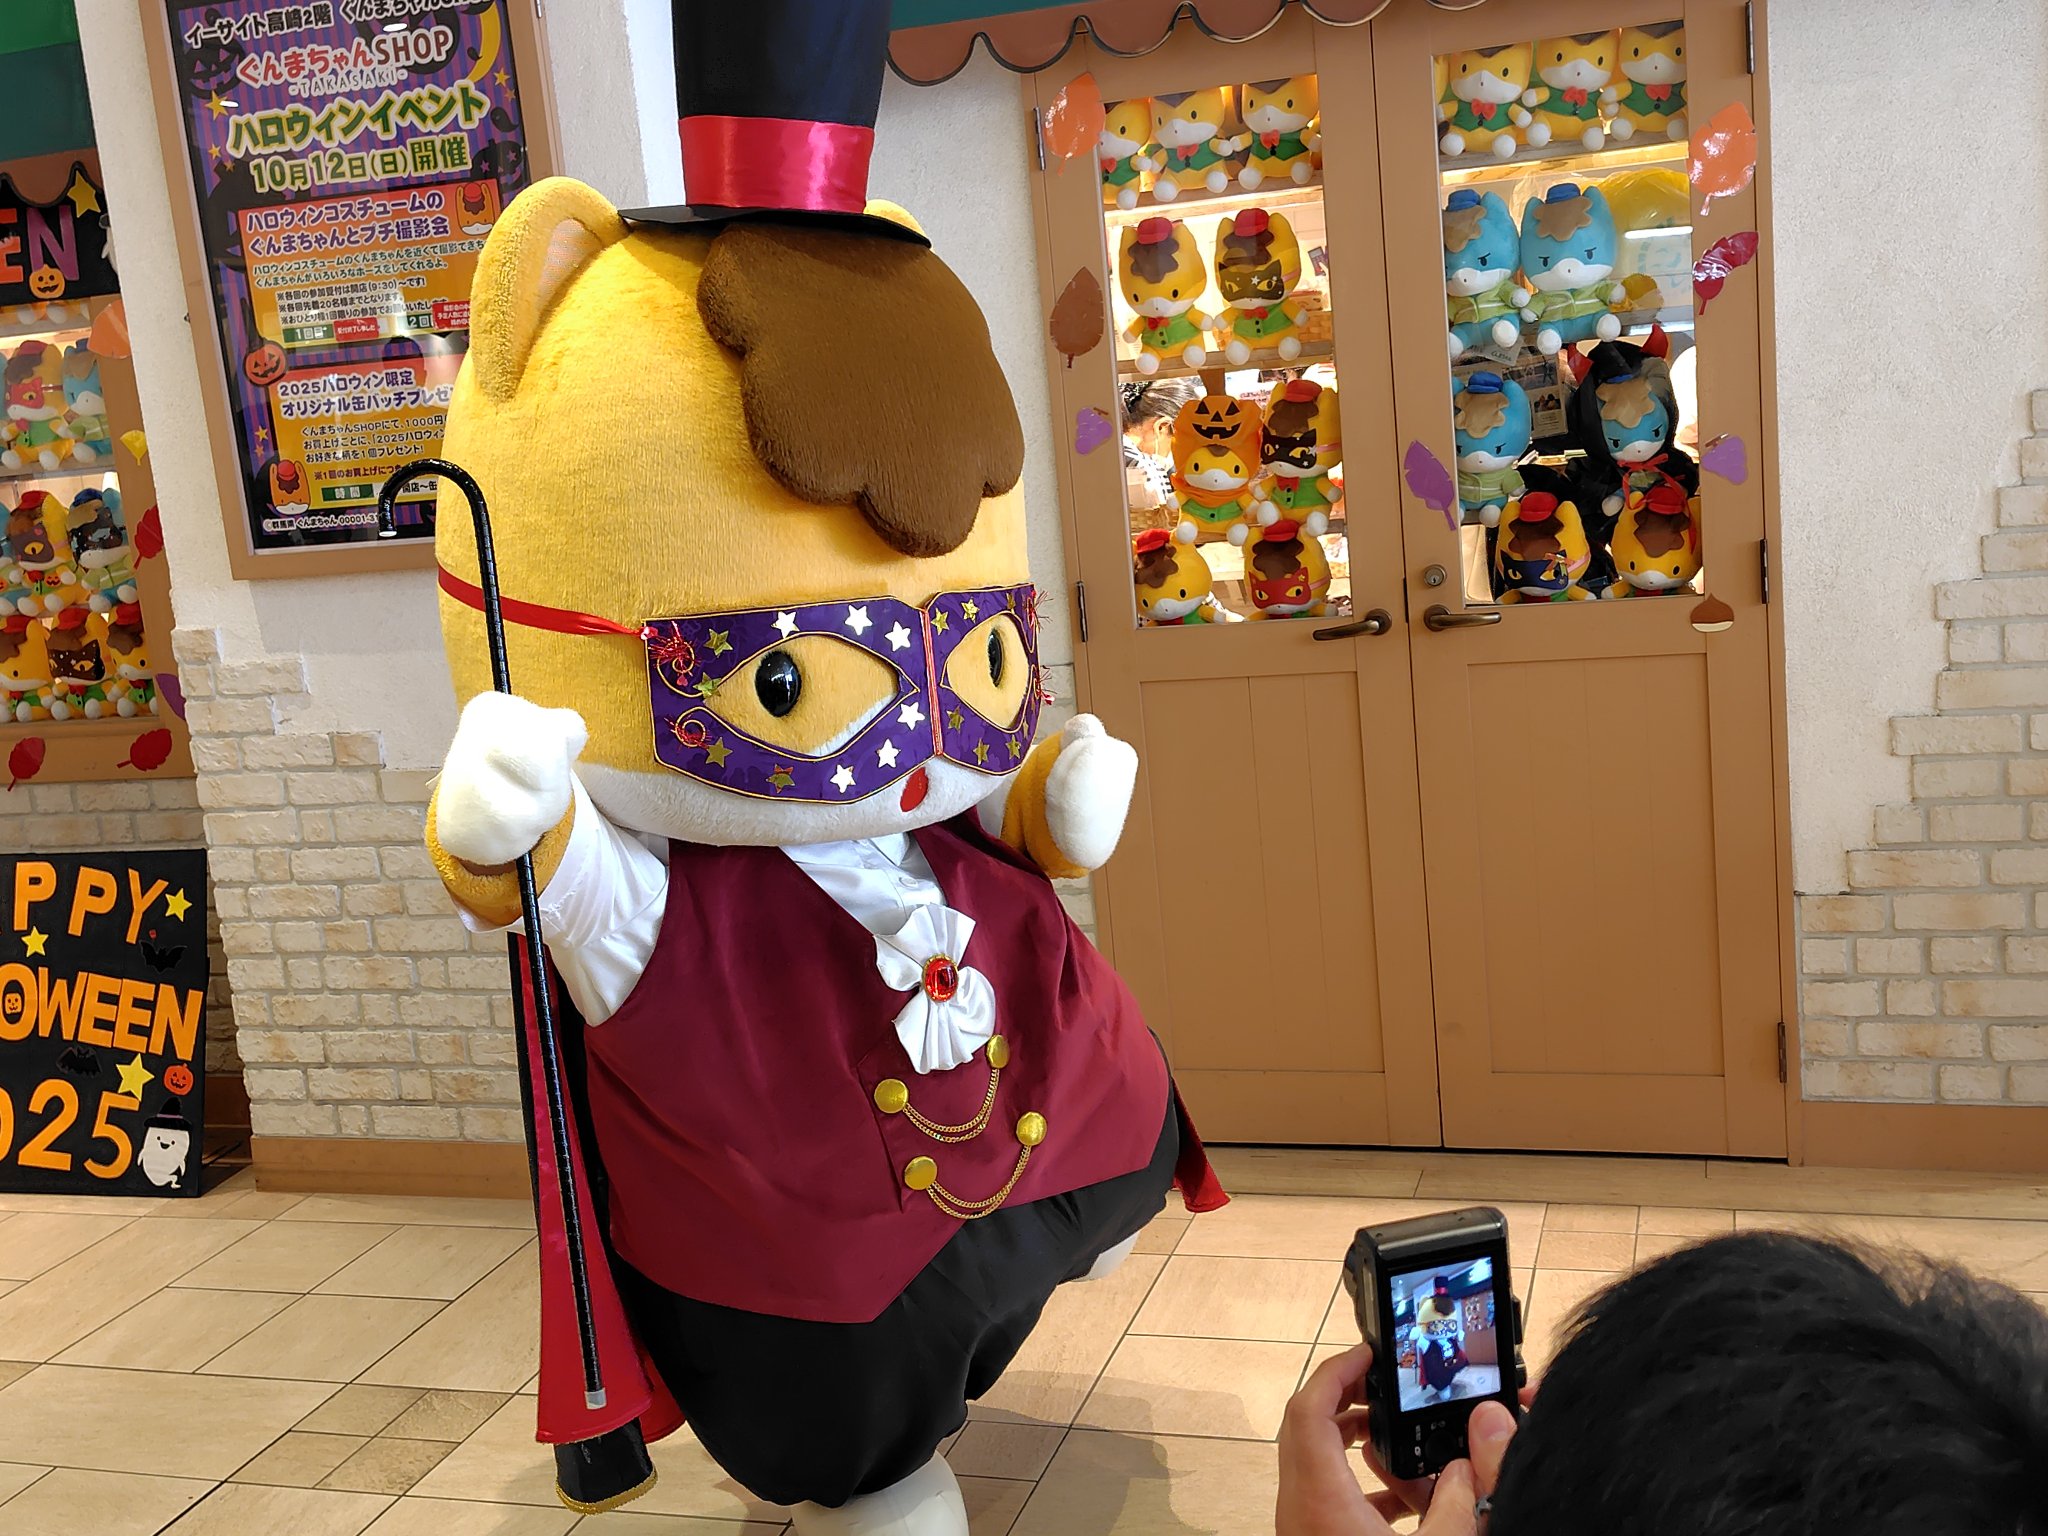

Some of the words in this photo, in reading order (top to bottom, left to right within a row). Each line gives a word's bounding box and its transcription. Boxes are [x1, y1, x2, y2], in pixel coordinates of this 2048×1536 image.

[187, 3, 332, 47] イーサイト高崎2階
[236, 28, 453, 87] ぐんまちゃんSHOP
[230, 83, 487, 154] ハロウィンイベント
[251, 136, 470, 191] 10月12日(日)開催
[247, 191, 444, 231] ハロウィンコスチュームの
[249, 217, 450, 256] ぐんまちゃんとプチ撮影会
[279, 370, 413, 396] 2025ハロウィン限定
[0, 861, 168, 944] PPY
[0, 962, 204, 1061] OWEEN
